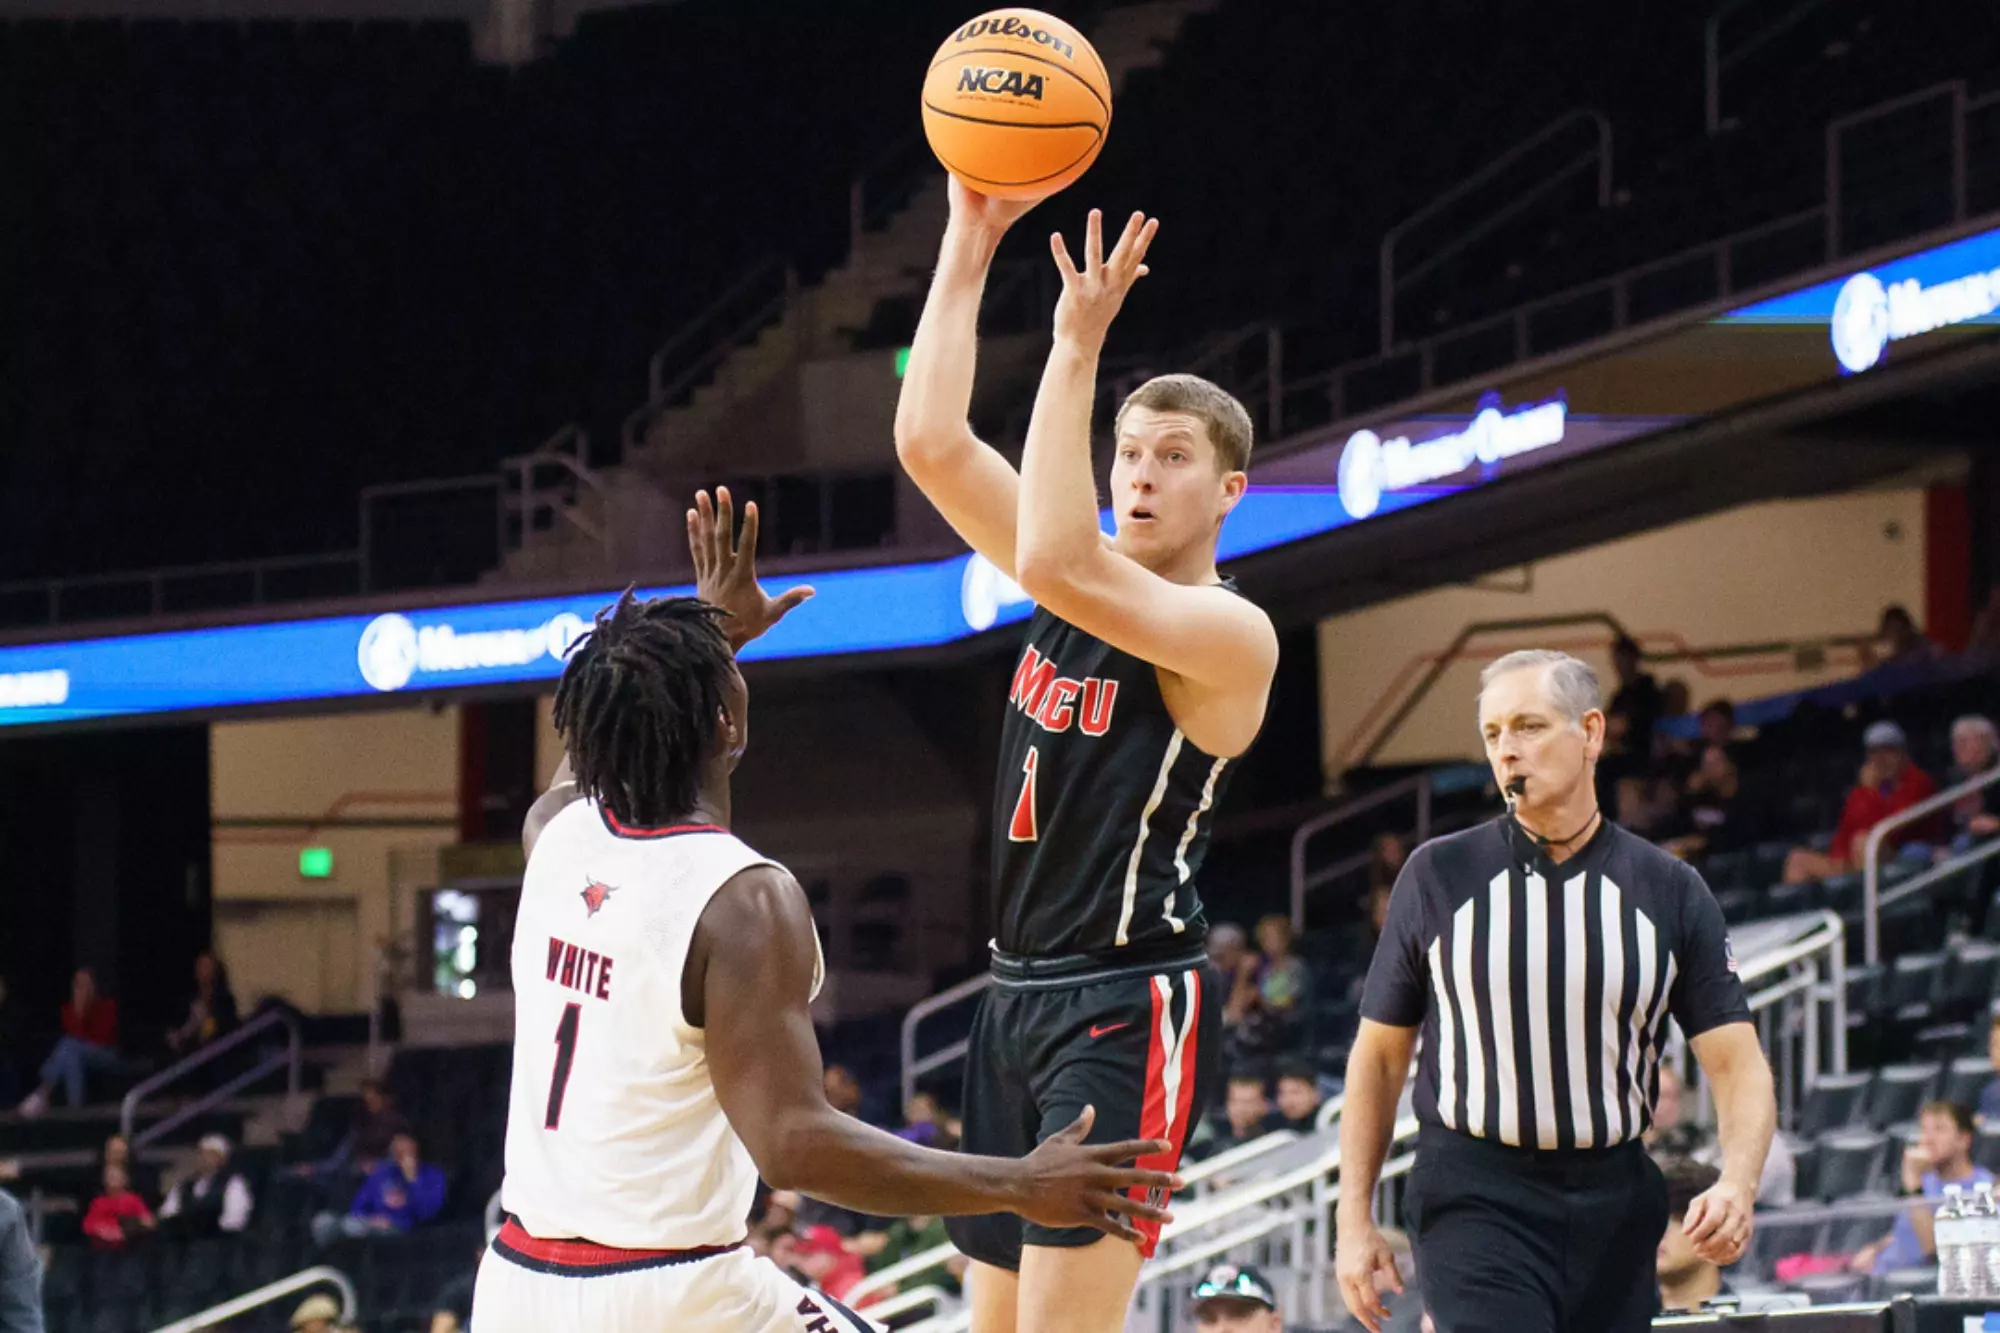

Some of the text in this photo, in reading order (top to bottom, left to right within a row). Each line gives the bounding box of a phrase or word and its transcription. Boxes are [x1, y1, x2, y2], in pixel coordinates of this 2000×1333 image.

[955, 17, 1074, 60] Wilson
[957, 67, 1045, 101] NCAA
[1009, 643, 1120, 737] MCU
[1008, 745, 1039, 843] 1
[545, 936, 614, 1001] WHITE
[544, 1001, 582, 1130] 1
